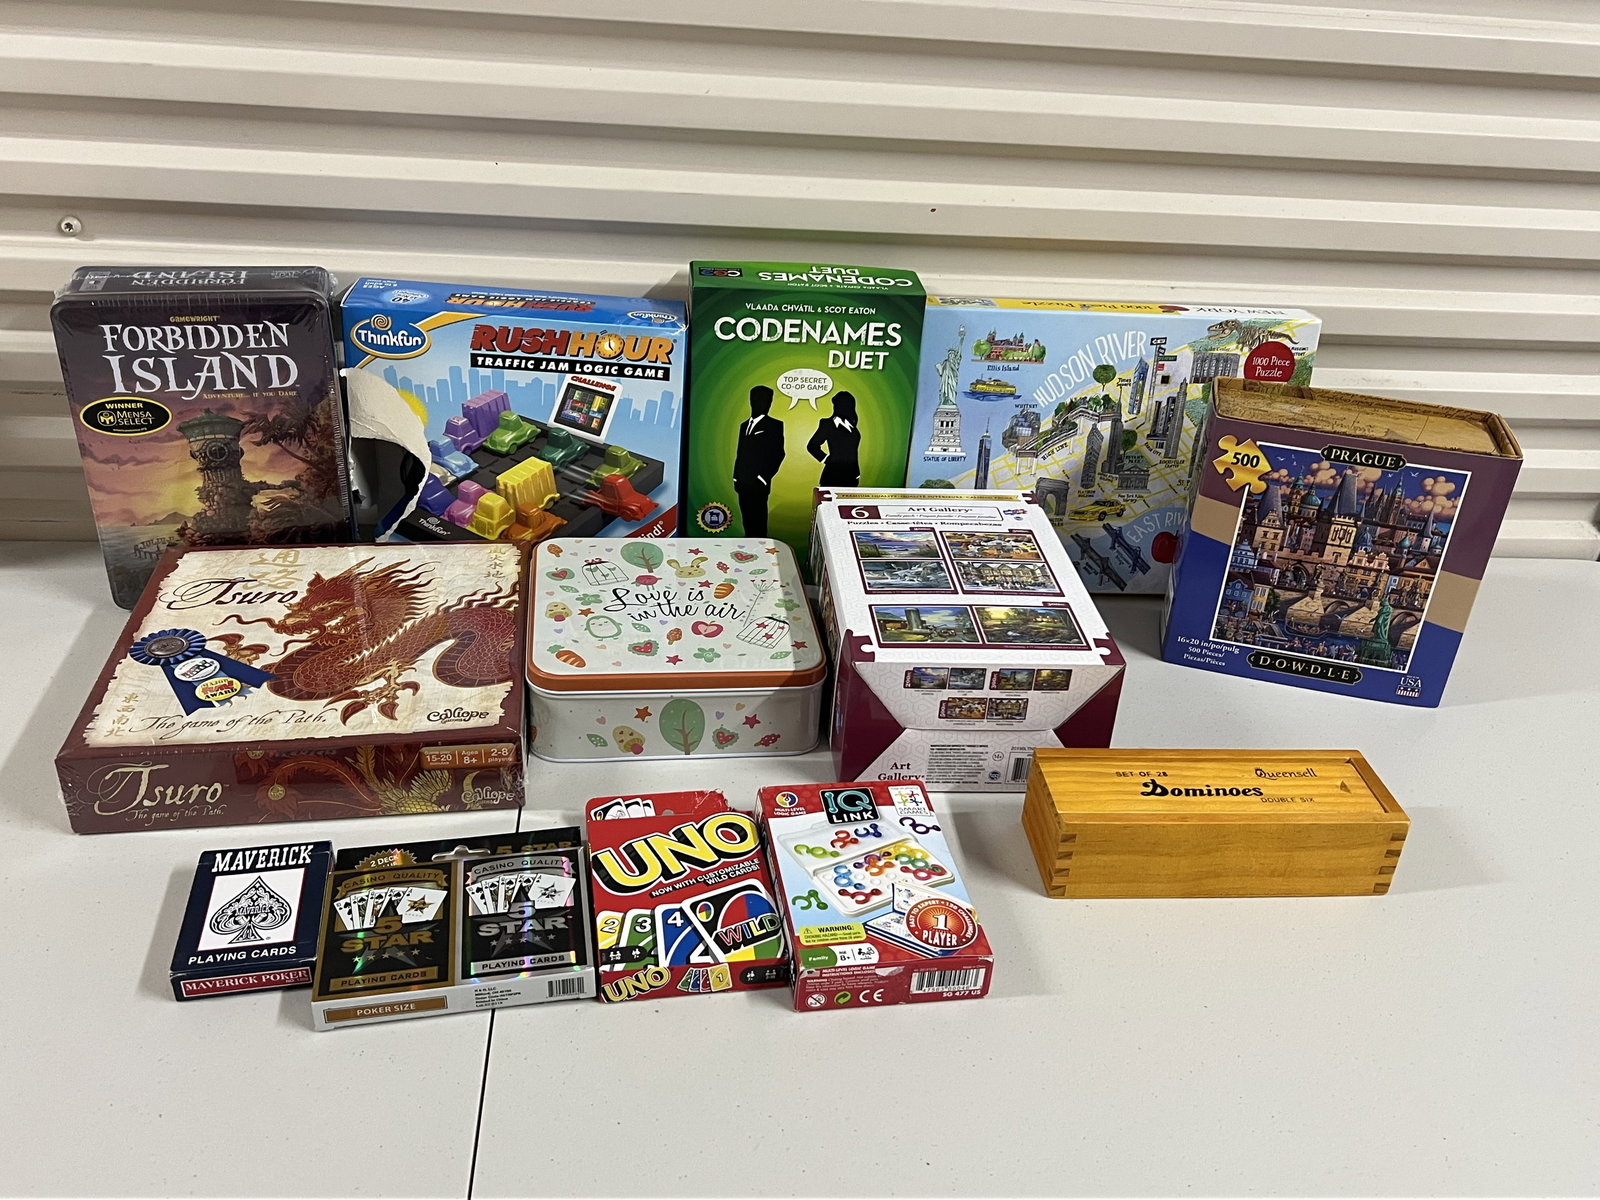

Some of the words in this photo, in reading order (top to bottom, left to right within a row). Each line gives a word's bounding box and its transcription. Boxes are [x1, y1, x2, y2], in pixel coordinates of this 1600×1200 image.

[131, 270, 248, 280] ISLAND
[758, 271, 913, 287] CODENAMES
[810, 266, 860, 276] DUET
[131, 278, 246, 286] FORBIDDEN
[745, 302, 780, 312] VLAADA
[781, 303, 815, 313] CHVÁTIL
[824, 305, 847, 314] SCOT
[848, 306, 876, 315] EATON
[99, 321, 290, 353] FORBIDDEN
[358, 329, 423, 348] ThinkFun
[714, 316, 903, 347] CODENAMES
[476, 356, 536, 370] TRAFFIC
[540, 359, 571, 372] JAM
[575, 362, 621, 376] LOGIC
[623, 366, 666, 379] GAME
[828, 350, 890, 370] DUET
[986, 364, 1001, 372] Ellis
[1001, 364, 1021, 372] Island
[1252, 356, 1269, 366] 1000
[1270, 355, 1291, 367] Piece
[102, 351, 299, 400] ISLAND
[1033, 343, 1098, 408] HUDSON
[1095, 330, 1147, 366] RIVER
[1255, 365, 1283, 377] Puzzle
[571, 376, 618, 391] CHALLENGE
[781, 382, 806, 391] CO-OP
[807, 383, 829, 392] GAME
[783, 375, 799, 384] TOP
[800, 376, 828, 385] SECRET
[117, 410, 153, 419] MENSA
[118, 417, 154, 426] SELECT
[1055, 442, 1069, 454] LINE
[1231, 451, 1261, 469] 500
[1330, 449, 1397, 468] PRAGUE
[851, 506, 870, 519] 6
[1126, 513, 1161, 543] EAST
[1165, 511, 1185, 528] RIV
[160, 577, 298, 610] Tsuro
[603, 587, 678, 612] Love
[687, 587, 705, 602] is
[627, 610, 657, 622] in
[655, 601, 700, 618] the
[704, 602, 746, 620] air
[1188, 646, 1201, 654] 500
[1201, 640, 1240, 654] in/po/pulg
[1400, 677, 1421, 688] USA
[204, 688, 238, 699] AWARD
[427, 707, 490, 722] Calliope
[129, 715, 184, 733] The
[160, 720, 221, 740] game
[216, 715, 246, 733] of
[249, 710, 280, 726] the
[426, 754, 452, 762] 15-20
[463, 756, 478, 764] 8+
[490, 748, 509, 757] 2-8
[890, 762, 911, 770] Art
[1255, 768, 1317, 780] Queensell
[877, 772, 921, 781] Gallery
[87, 761, 222, 815] Tsuro
[461, 786, 515, 804] Calliope
[1140, 779, 1264, 797] Dominoes
[824, 790, 873, 814] IQ
[126, 808, 149, 821] The
[145, 812, 169, 826] game
[170, 809, 184, 821] of
[184, 805, 199, 817] the
[832, 810, 875, 824] LINK
[211, 844, 314, 873] MAVERICK
[377, 854, 398, 865] DECK
[593, 813, 760, 895] UNO
[474, 861, 515, 875] CASINO
[706, 874, 728, 885] WILD
[729, 865, 760, 880] CARDS!
[344, 874, 386, 889] CASINO
[393, 872, 440, 880] QUALITY
[652, 885, 673, 897] NOW
[674, 878, 697, 891] WITH
[697, 858, 760, 882] CUSTOMIZABLE
[234, 904, 272, 917] MAVERICK
[506, 900, 536, 919] 5
[918, 899, 940, 910] EXPERT
[373, 915, 403, 935] 5
[477, 916, 569, 937] STAR
[600, 918, 620, 934] 2
[634, 917, 652, 933] 3
[667, 911, 685, 927] 4
[933, 914, 949, 931] 1
[718, 915, 780, 946] WILD
[818, 925, 855, 933] WARNING:
[341, 930, 434, 953] STAR
[922, 930, 958, 946] PLAYER
[188, 951, 247, 965] PLAYING
[251, 946, 297, 959] CARDS
[481, 959, 526, 971] PLAYING
[530, 954, 566, 965] CARDS
[185, 974, 259, 992] MAVERICK
[262, 970, 308, 983] POKER
[341, 975, 387, 987] PLAYING
[390, 971, 428, 982] CARDS
[602, 966, 671, 1003] UNO
[859, 989, 884, 1003] CE
[357, 1004, 392, 1017] POKER
[393, 1002, 416, 1013] SIZE
